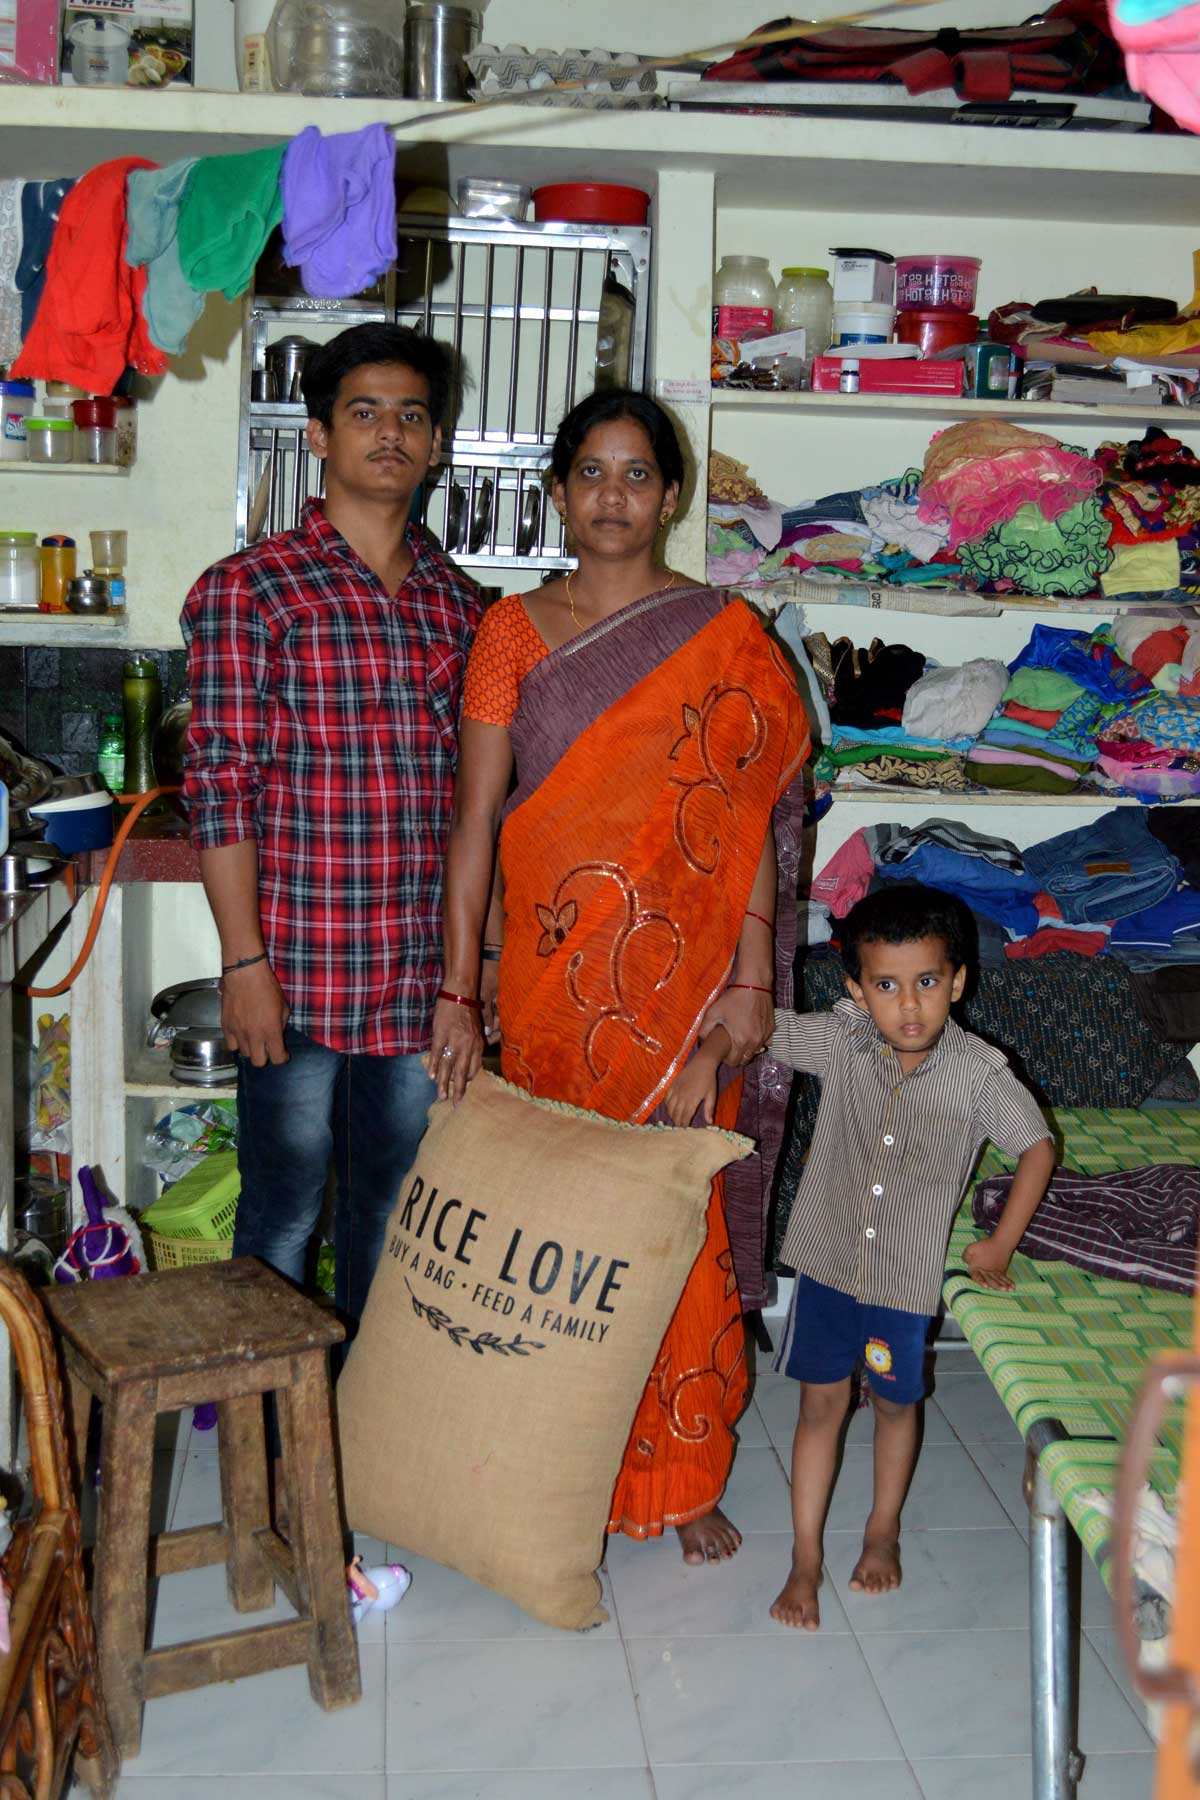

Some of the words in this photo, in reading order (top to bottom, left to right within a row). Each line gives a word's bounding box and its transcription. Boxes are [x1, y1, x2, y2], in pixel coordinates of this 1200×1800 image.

[388, 1235, 410, 1263] BUY
[410, 1252, 419, 1272] A
[424, 1259, 456, 1290] BAG
[471, 1283, 516, 1316] FEED
[520, 1303, 533, 1324] A
[540, 1309, 610, 1344] FAMILY
[399, 1175, 487, 1266] RICE
[498, 1228, 630, 1314] LOVE
